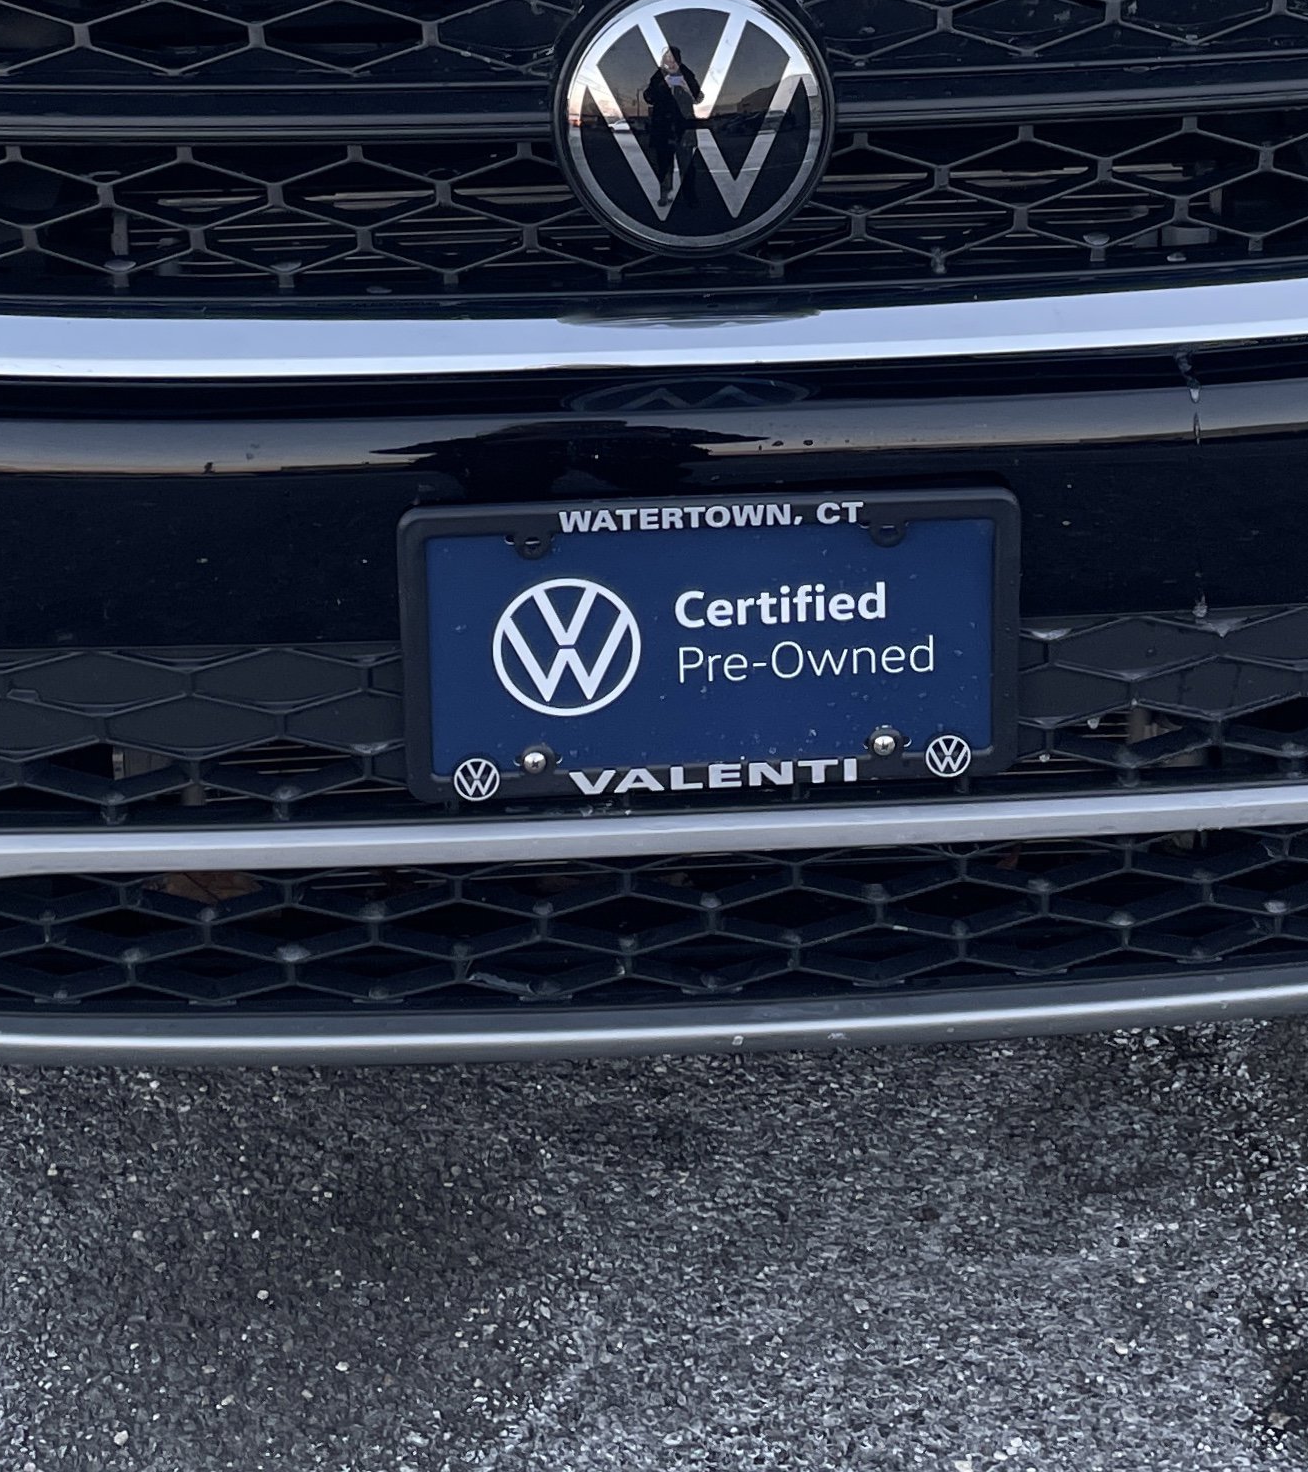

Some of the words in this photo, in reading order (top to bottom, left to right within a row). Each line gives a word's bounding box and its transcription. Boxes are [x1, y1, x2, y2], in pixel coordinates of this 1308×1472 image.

[558, 503, 803, 533] WATERTOWN,
[816, 501, 864, 525] CT
[674, 581, 886, 628] Certified
[492, 578, 641, 716] VW
[678, 634, 934, 683] Pre-Owned
[568, 758, 858, 796] VALENTI
